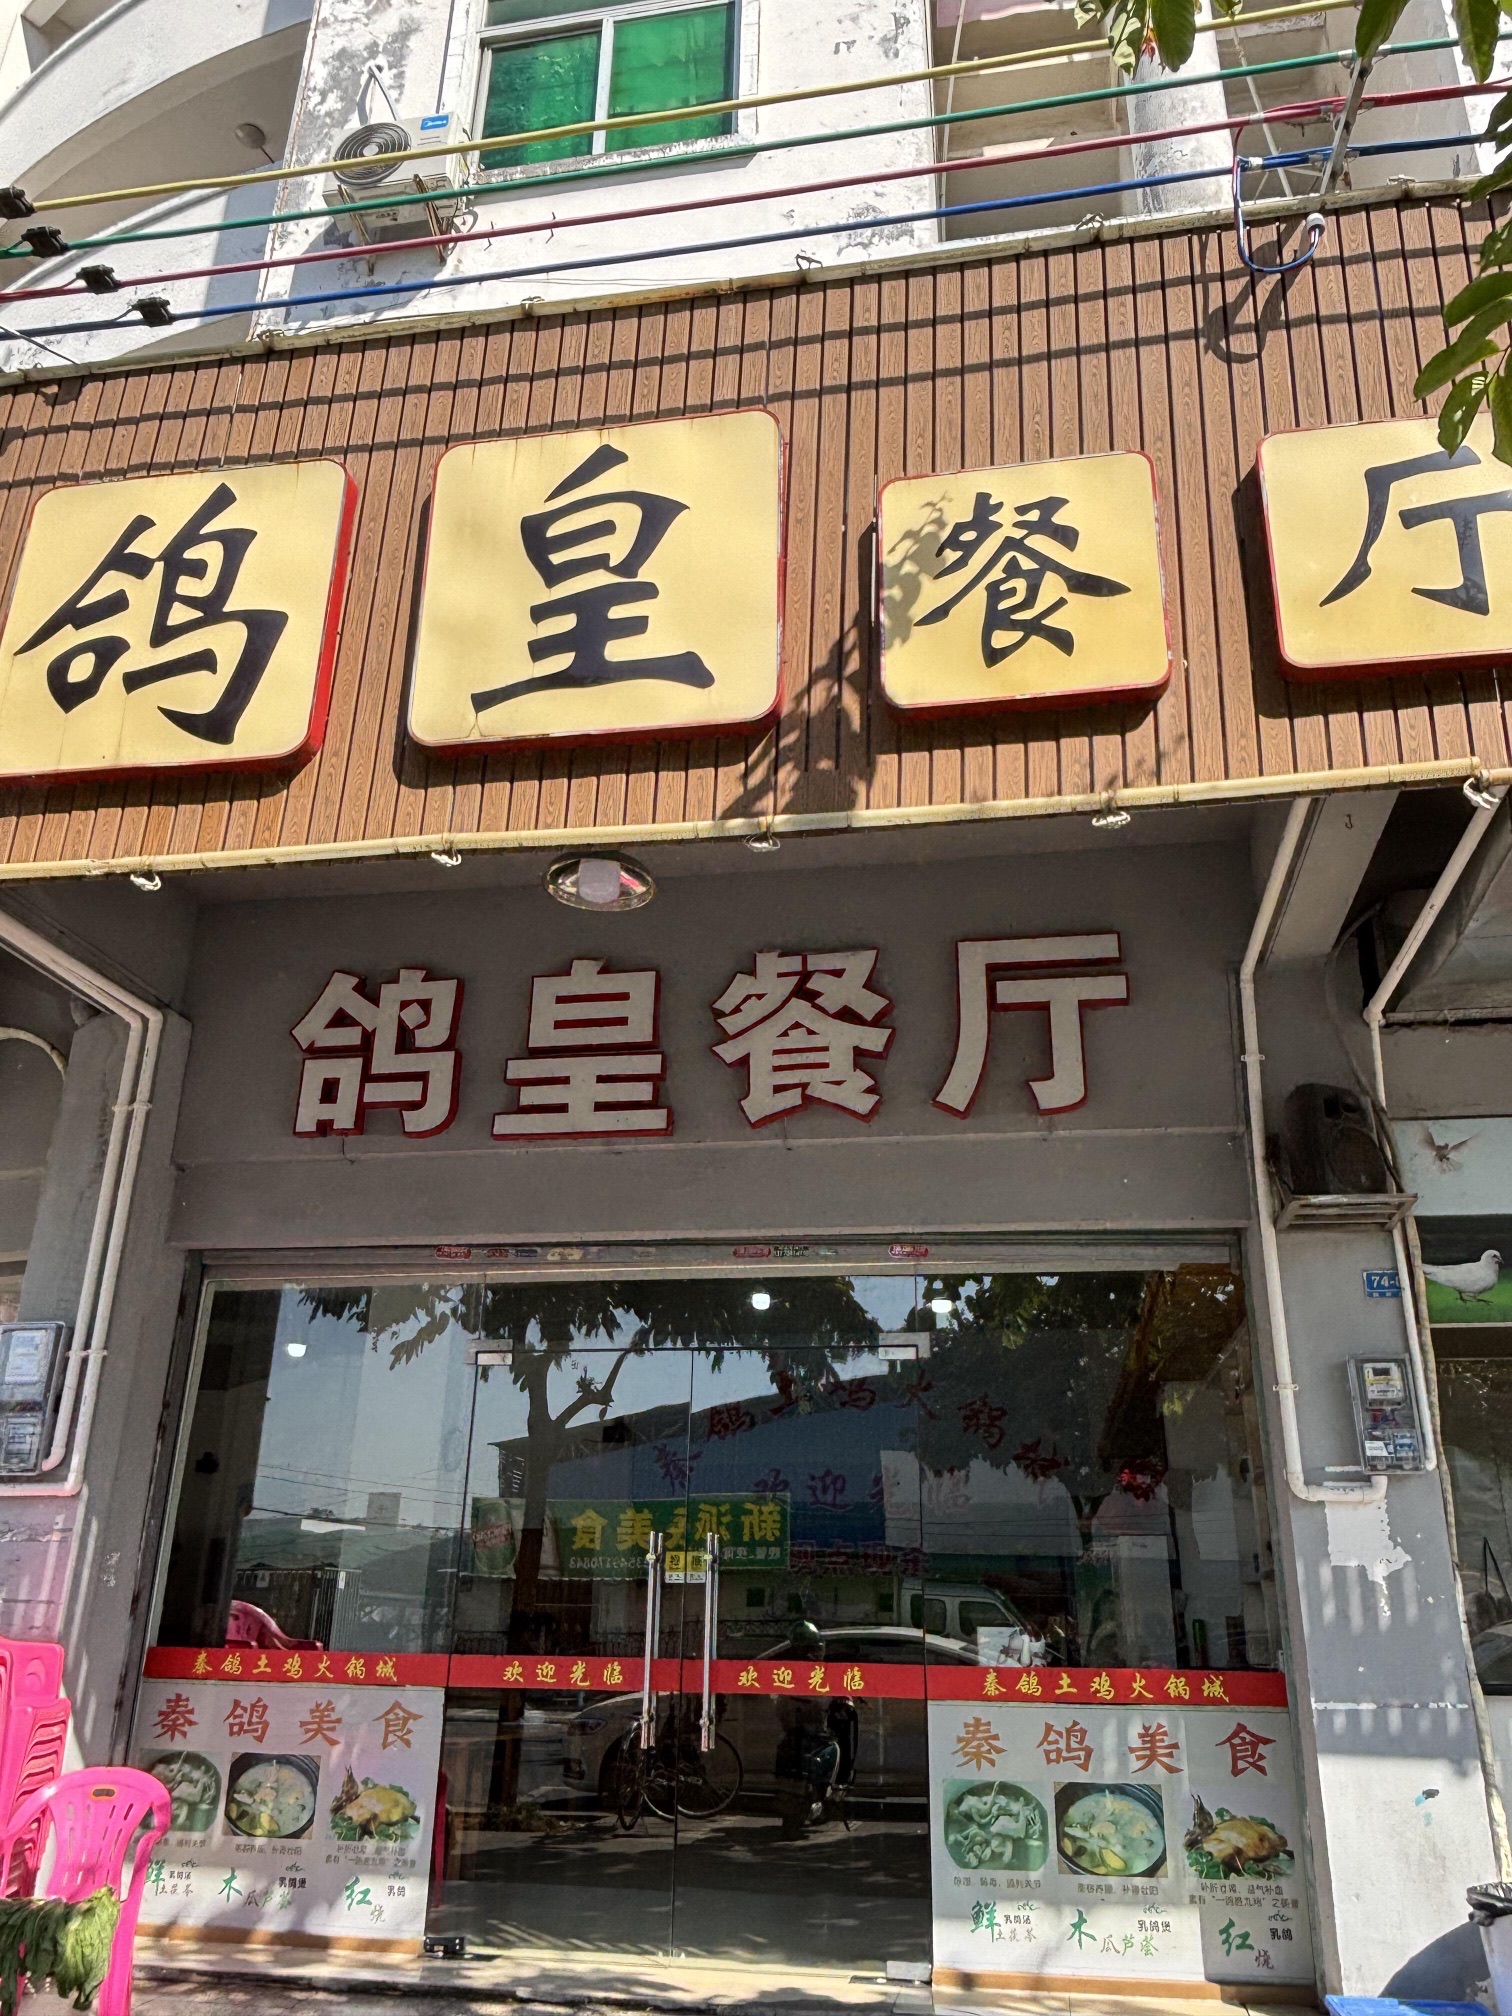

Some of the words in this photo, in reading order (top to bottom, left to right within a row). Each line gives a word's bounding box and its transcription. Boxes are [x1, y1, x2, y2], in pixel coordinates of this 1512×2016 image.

[13, 443, 1512, 746] 鸽皇餐厅
[290, 929, 1131, 1141] 鸽皇餐厅
[191, 1653, 399, 1682] 秦鸽土鸡火锅城
[502, 1660, 623, 1686] 欢迎光临
[737, 1665, 865, 1693] 欢迎光临
[981, 1668, 1230, 1703] 秦鸽土鸡火锅城
[152, 1692, 424, 1750] 秦鸽美食
[951, 1716, 1277, 1778] 秦鸽美食
